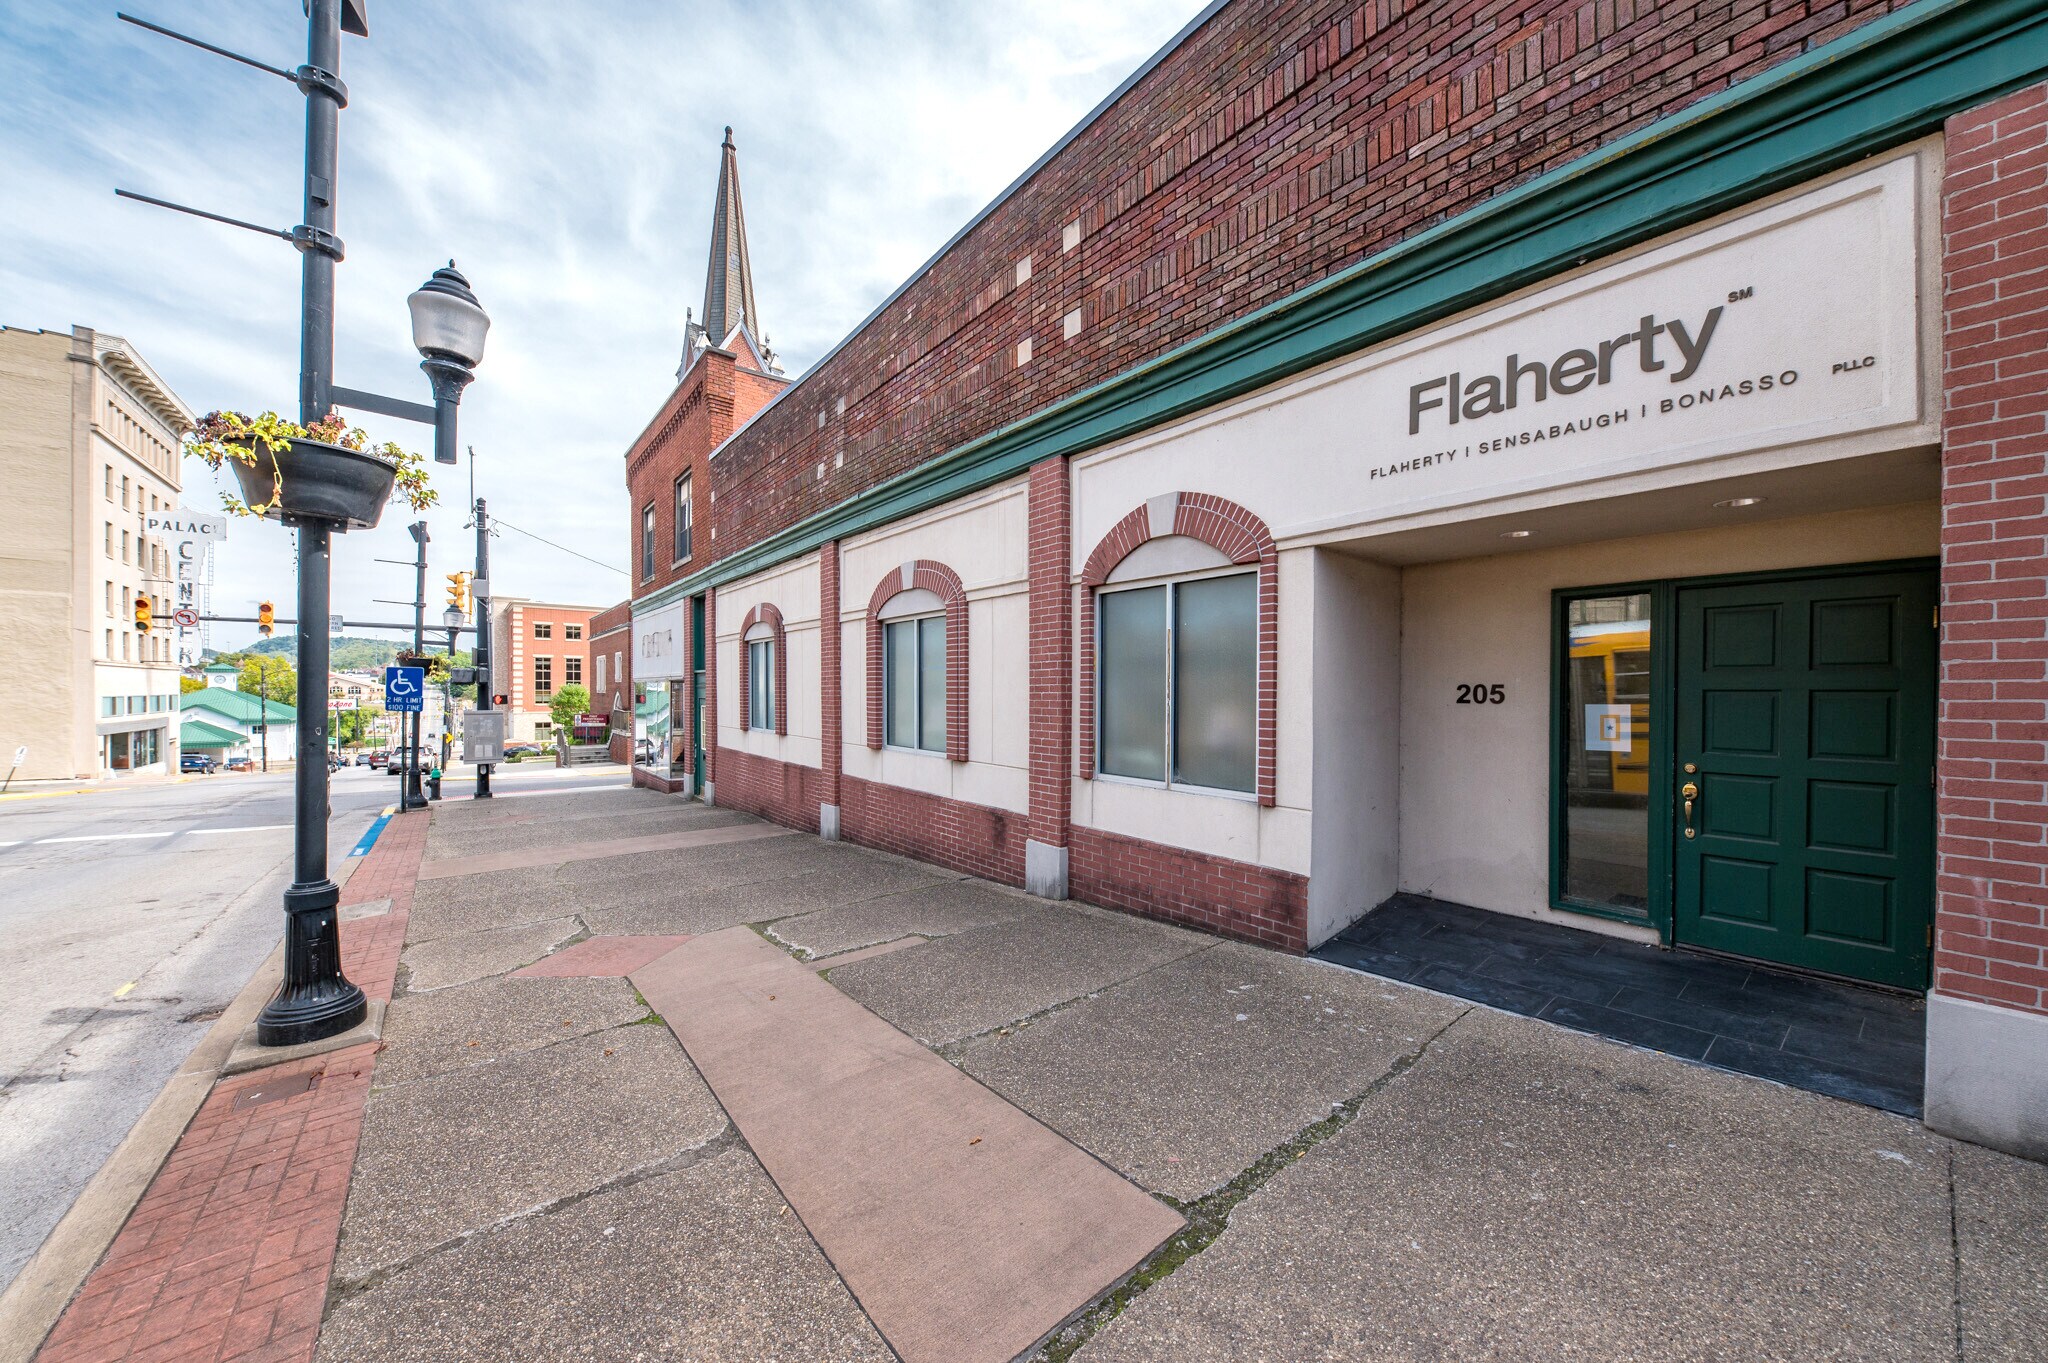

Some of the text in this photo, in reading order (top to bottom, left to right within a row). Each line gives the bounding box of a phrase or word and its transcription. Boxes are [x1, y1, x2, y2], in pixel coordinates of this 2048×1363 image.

[1370, 449, 1457, 480] FLAHERTY
[1478, 408, 1628, 454] SENSABAUGH
[1660, 369, 1798, 413] BONASSO
[1832, 356, 1876, 375] PLLC
[1409, 286, 1753, 435] Flaherty SM
[1456, 684, 1505, 704] 205
